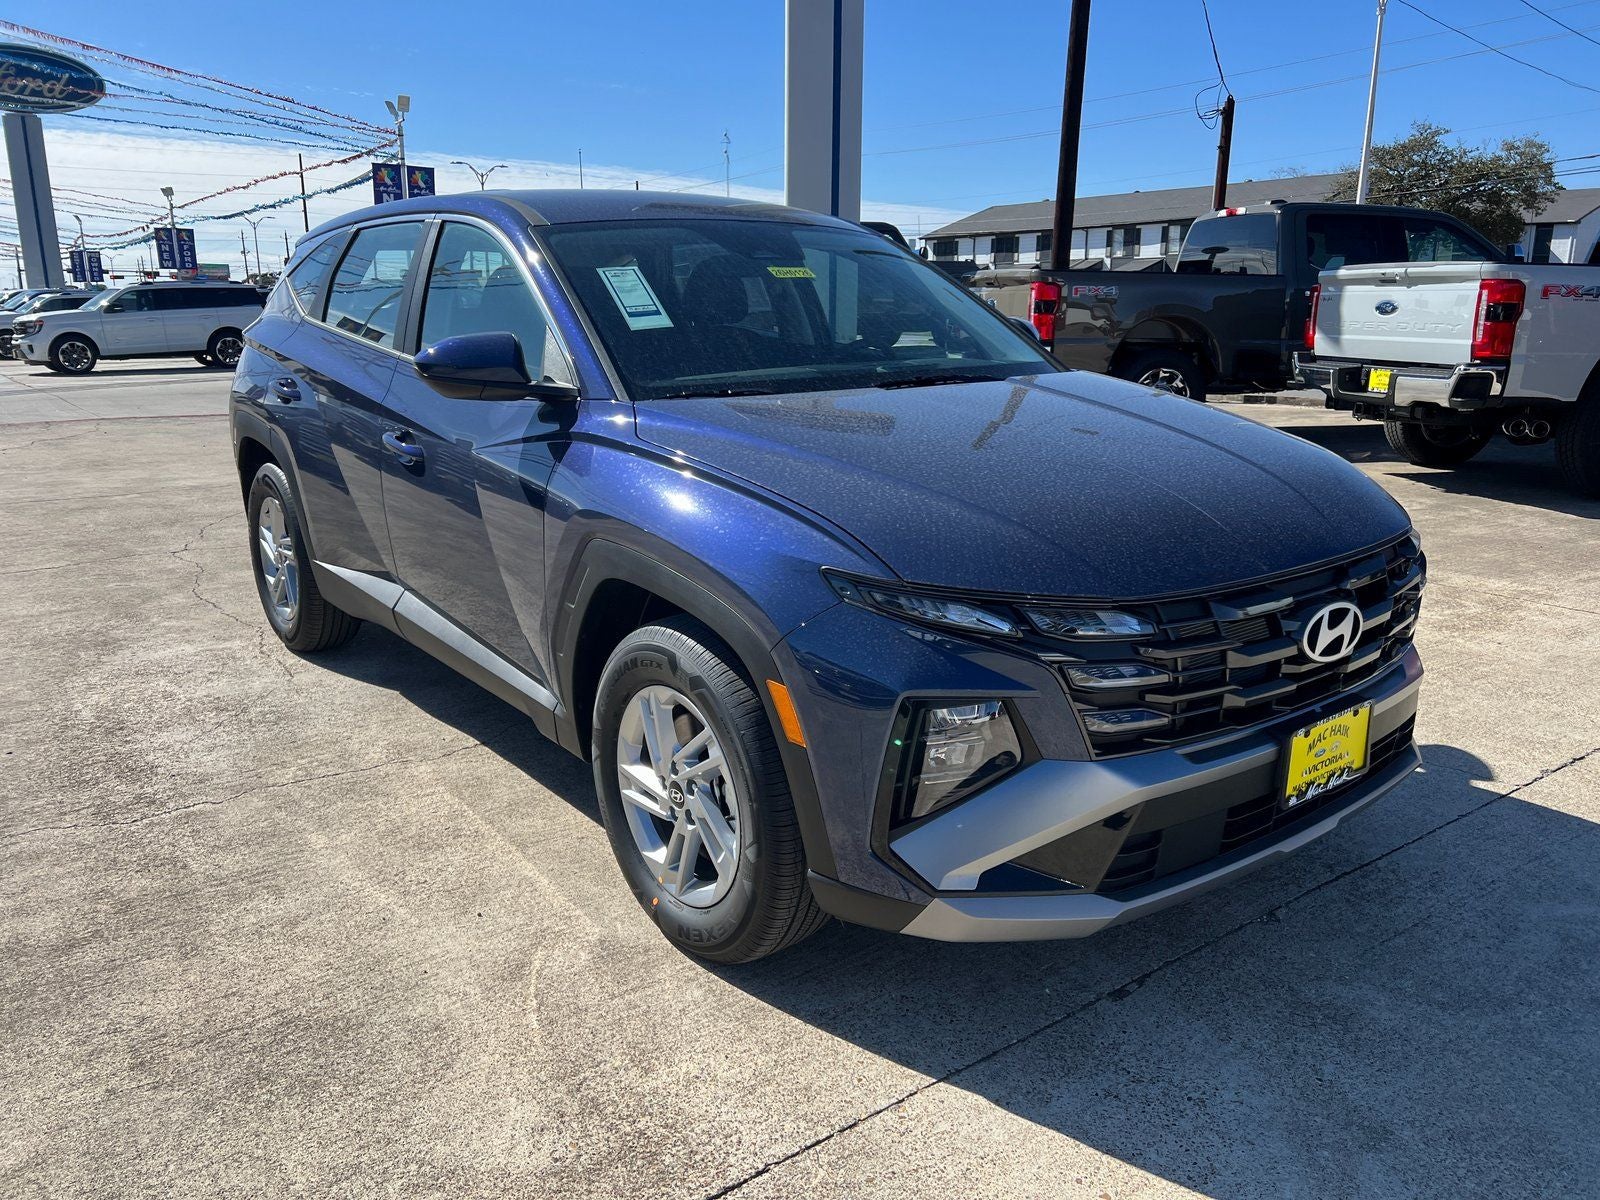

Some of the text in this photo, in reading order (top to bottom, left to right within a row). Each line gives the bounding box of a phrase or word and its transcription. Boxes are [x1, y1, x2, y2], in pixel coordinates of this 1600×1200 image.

[161, 244, 173, 267] NEW
[183, 244, 193, 268] FORD
[1072, 285, 1117, 297] FX4
[1540, 284, 1600, 299] FX4
[1323, 320, 1465, 333] SUPER DUTY
[1306, 727, 1329, 756] MAC
[1329, 723, 1350, 739] HAIK
[1308, 753, 1344, 775] VICTORIA
